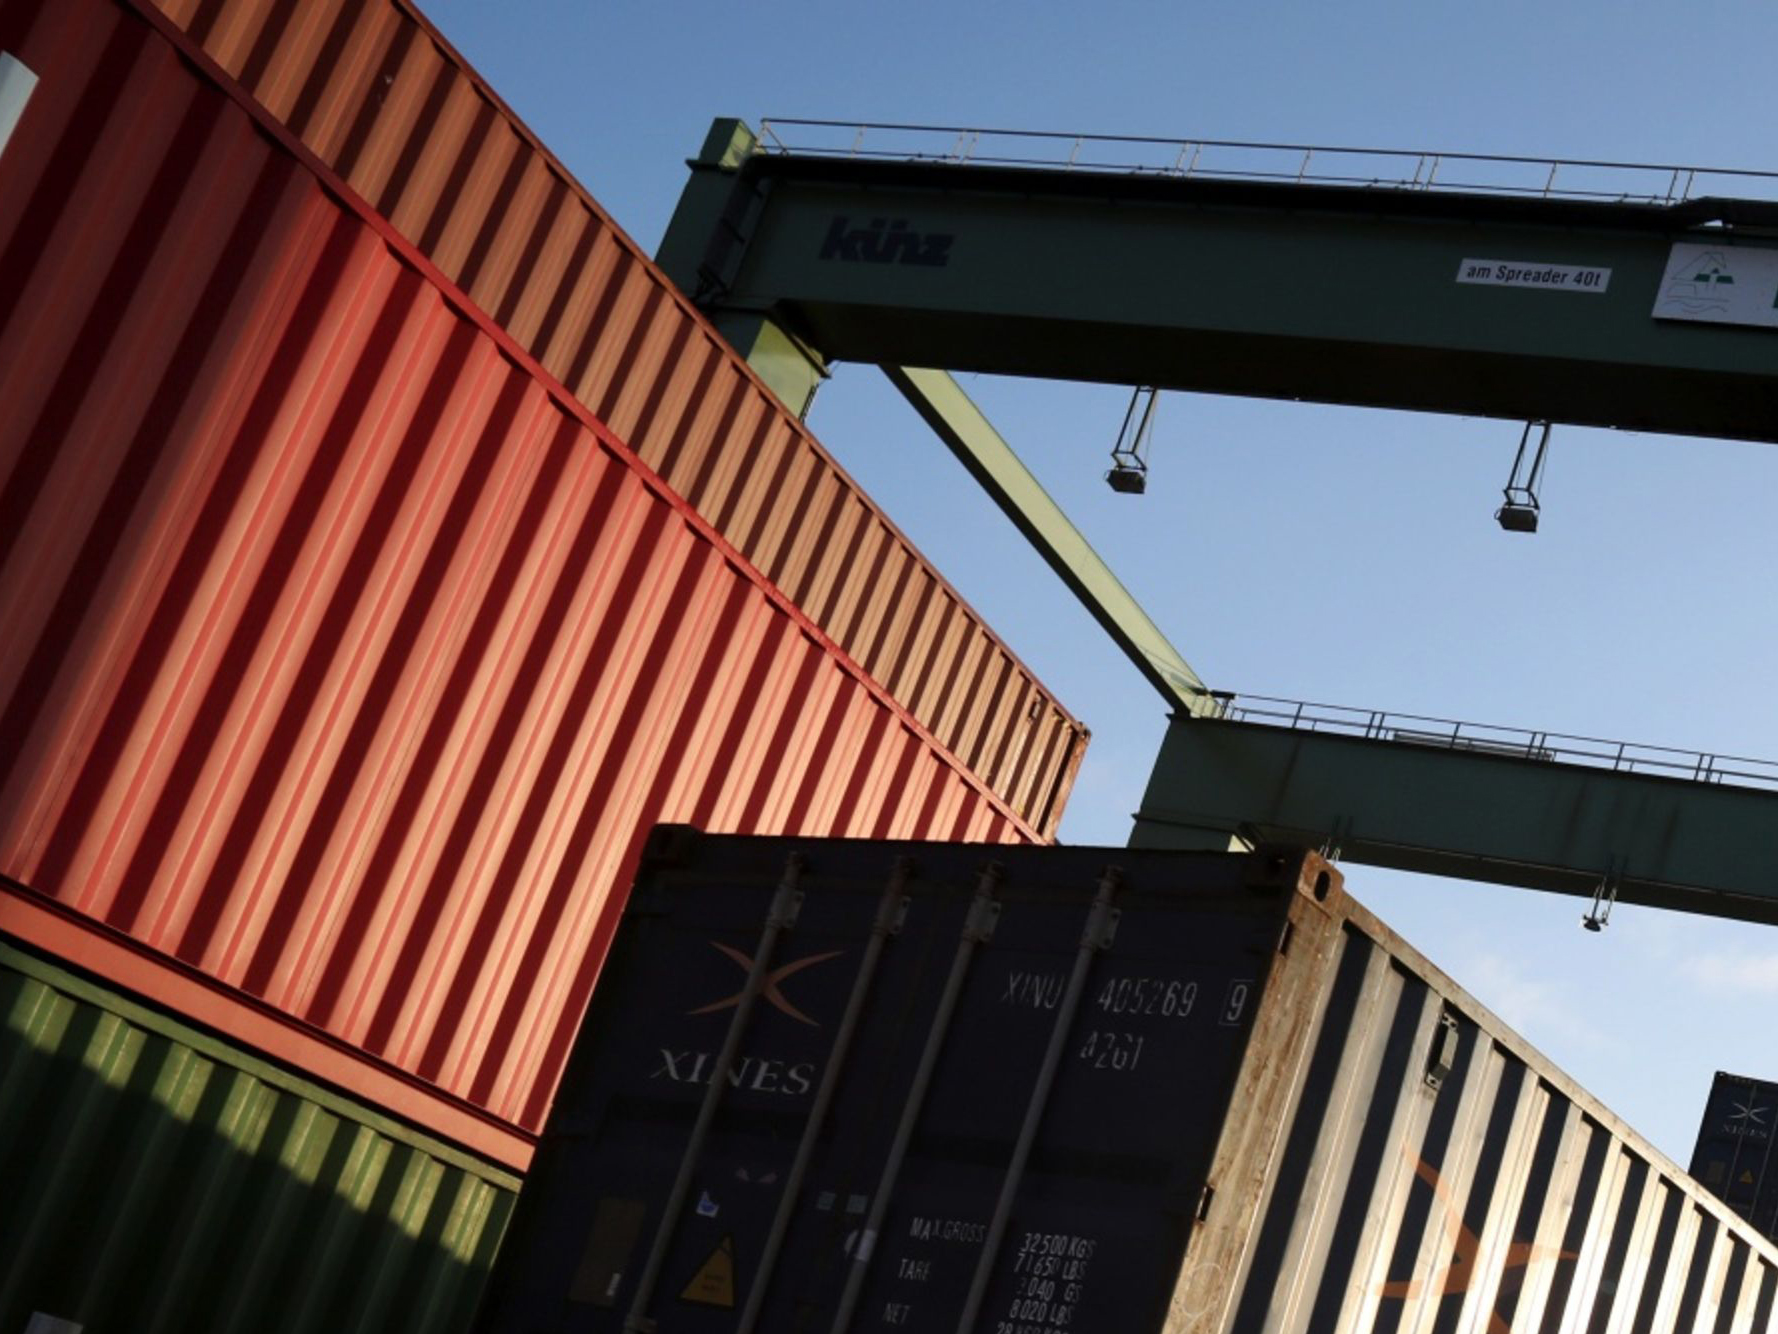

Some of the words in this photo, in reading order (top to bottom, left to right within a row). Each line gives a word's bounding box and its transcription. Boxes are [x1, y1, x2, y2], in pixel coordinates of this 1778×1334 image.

[1466, 264, 1491, 280] am
[1496, 264, 1569, 284] Spreader
[1573, 270, 1602, 288] 40t
[1225, 982, 1249, 1022] 9
[650, 1048, 817, 1096] XINES
